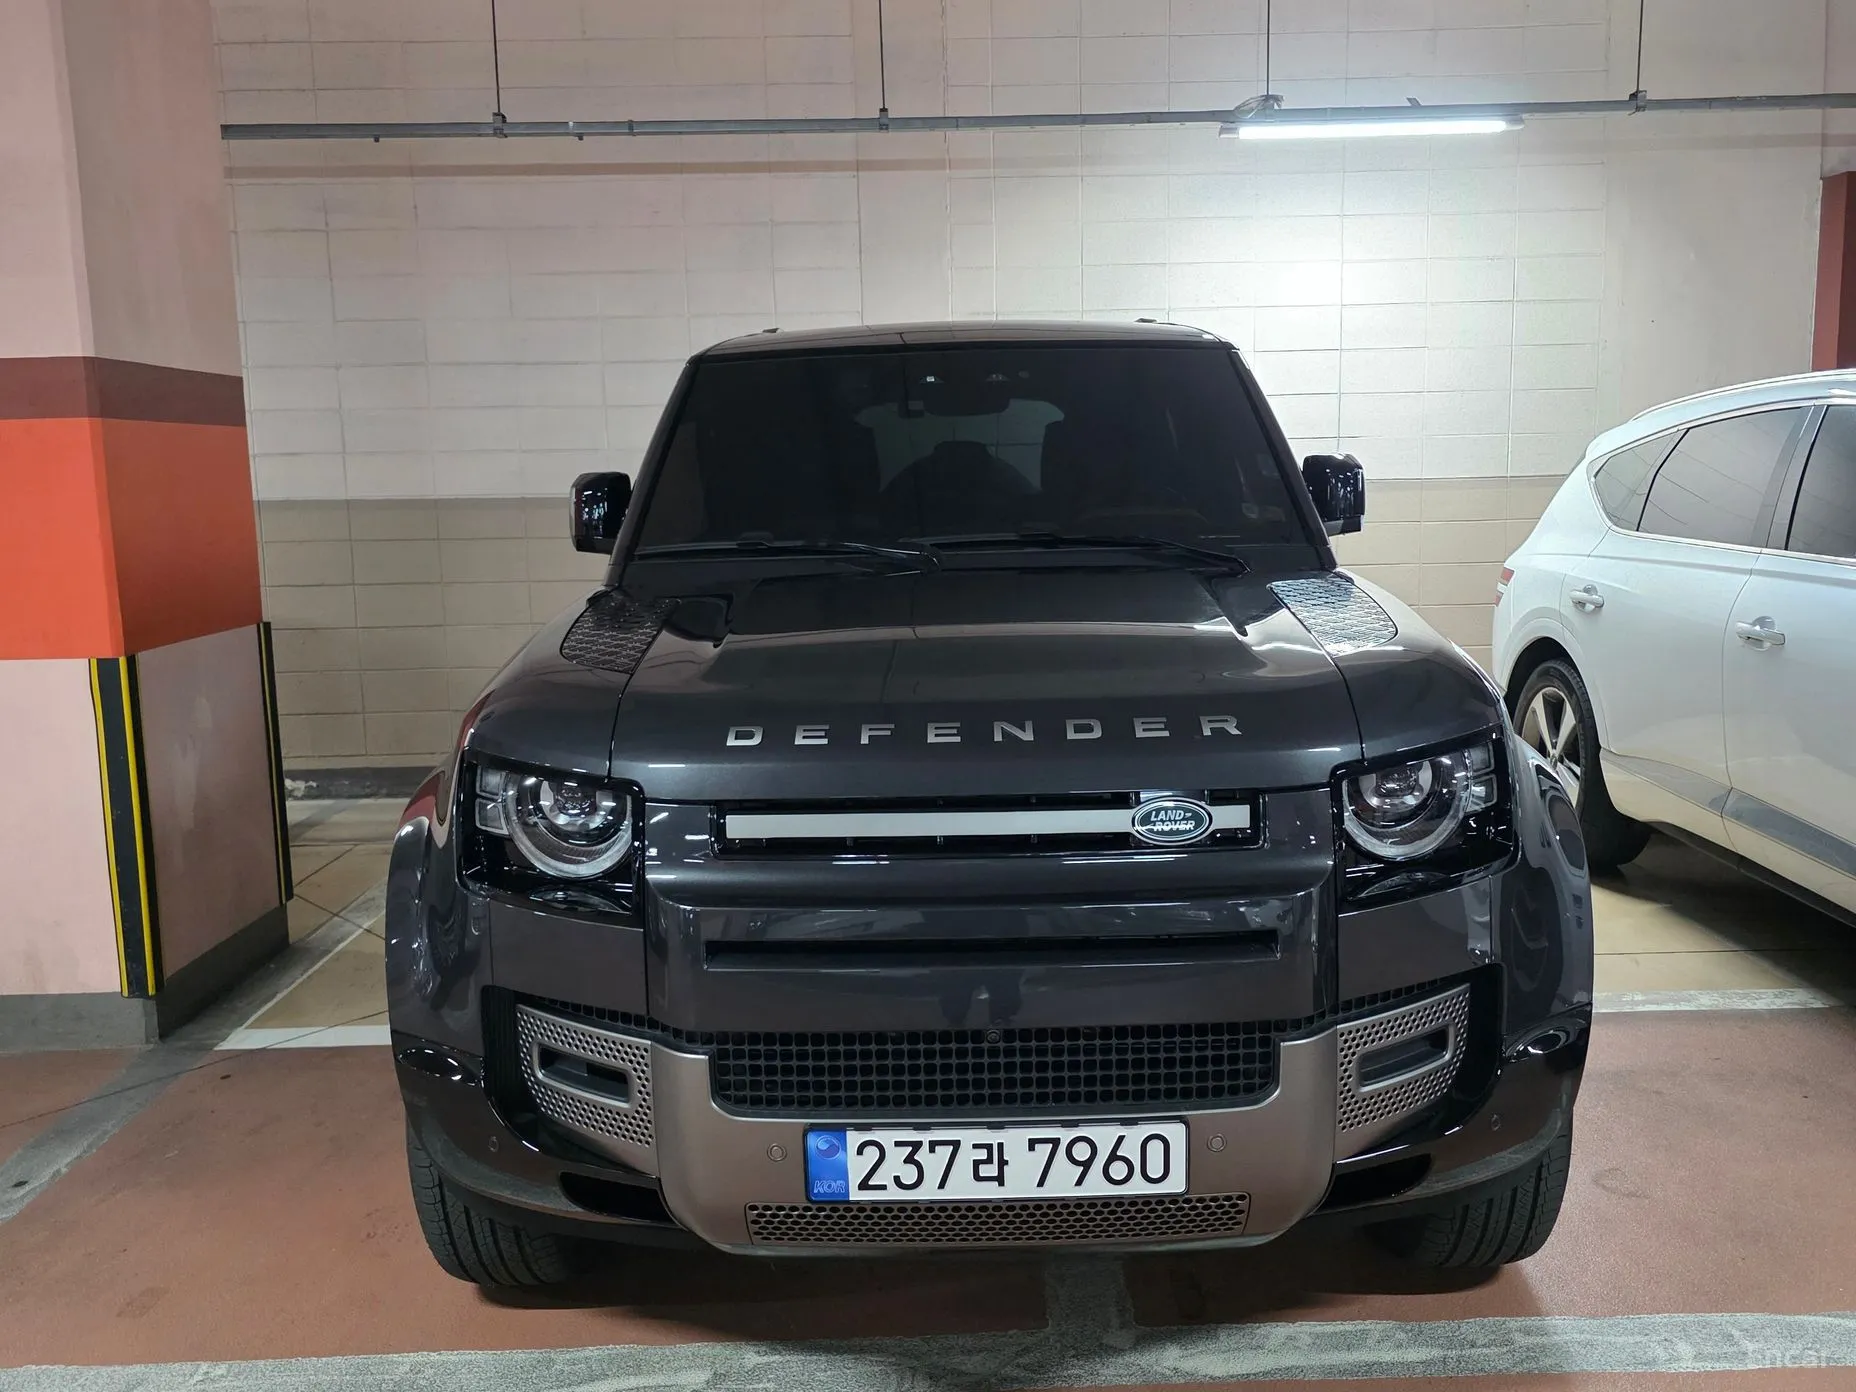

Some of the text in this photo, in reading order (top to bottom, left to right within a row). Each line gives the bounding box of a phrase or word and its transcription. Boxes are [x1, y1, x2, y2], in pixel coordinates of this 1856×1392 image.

[725, 715, 1243, 747] DEFENDER
[1150, 810, 1185, 822] LAND
[1153, 820, 1196, 832] ROVER
[856, 1133, 1171, 1191] 237라 7960
[813, 1180, 846, 1194] KOR
